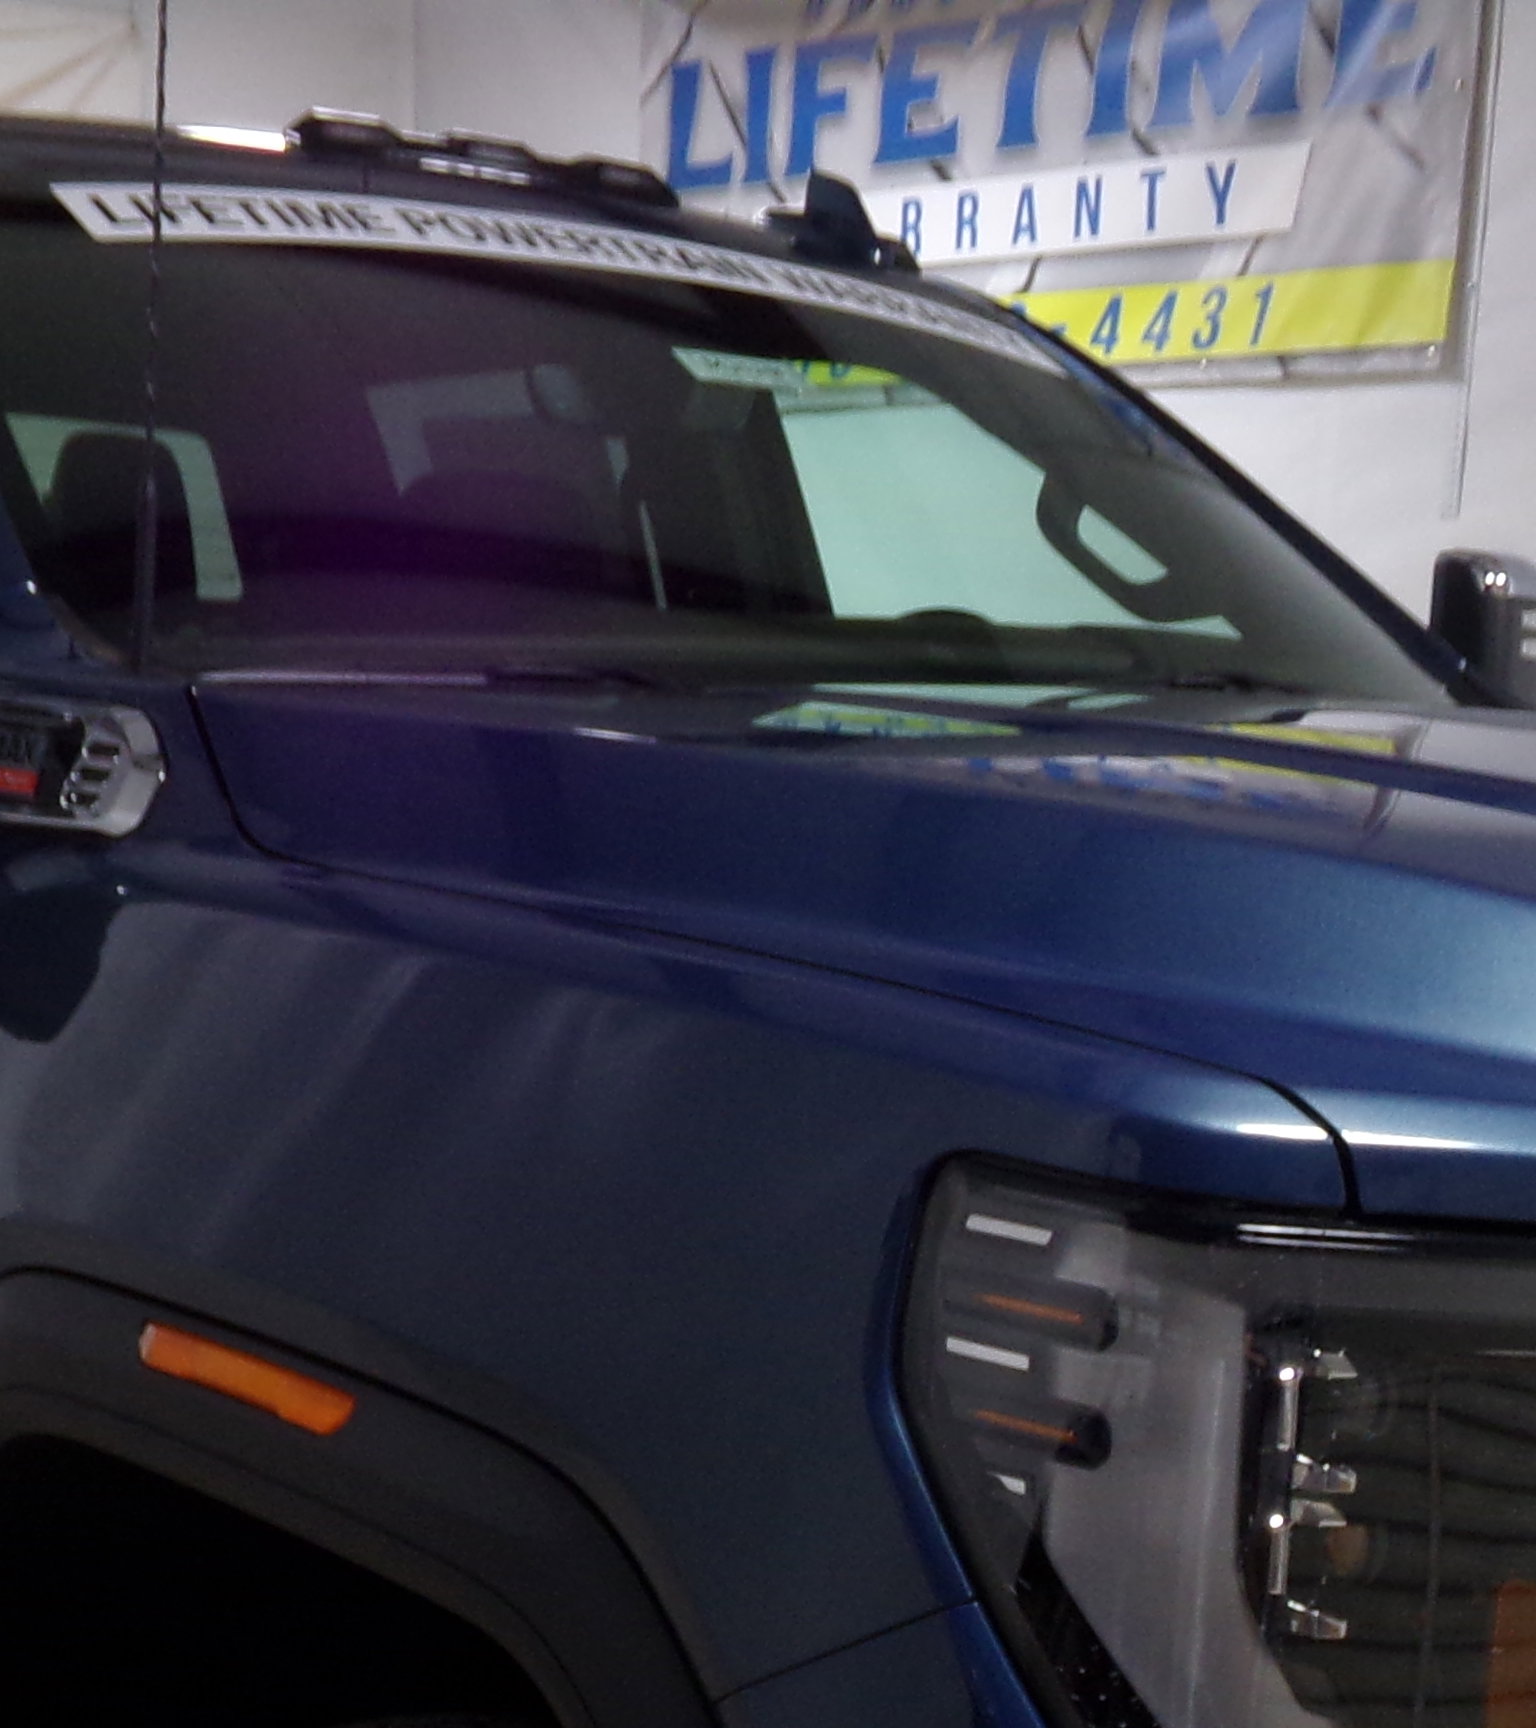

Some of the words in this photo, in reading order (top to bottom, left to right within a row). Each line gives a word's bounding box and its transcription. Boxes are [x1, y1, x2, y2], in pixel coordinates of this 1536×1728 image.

[667, 0, 1437, 190] LIFETIME
[86, 192, 395, 234] LIFETIME
[394, 204, 772, 285] POWERTRAIN
[900, 159, 1236, 256] RRANTY
